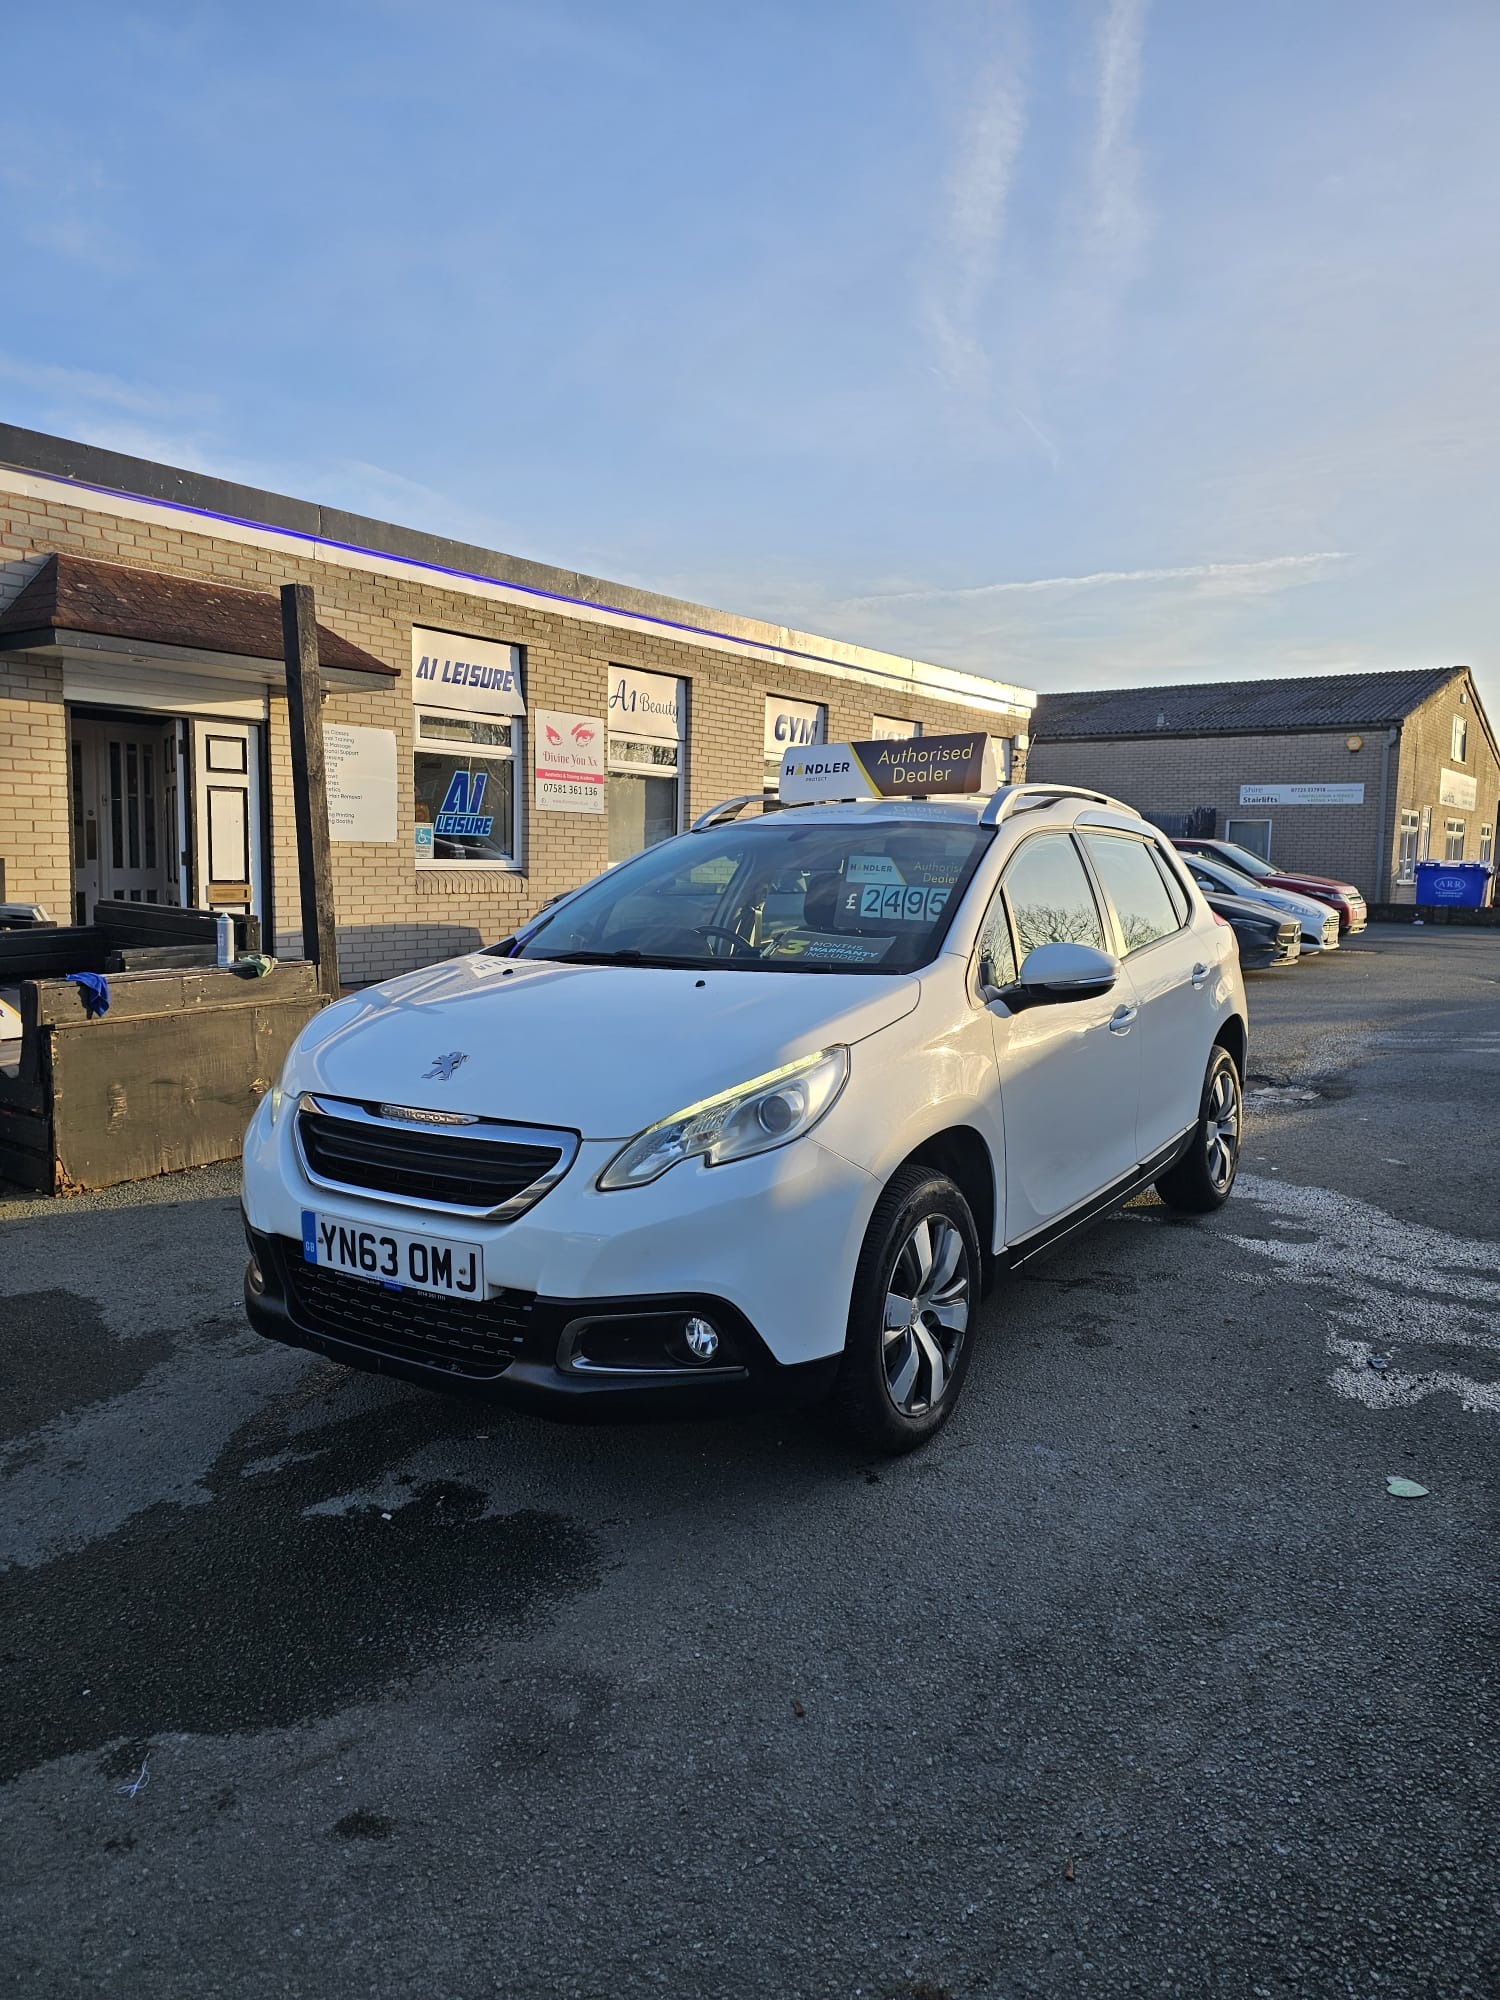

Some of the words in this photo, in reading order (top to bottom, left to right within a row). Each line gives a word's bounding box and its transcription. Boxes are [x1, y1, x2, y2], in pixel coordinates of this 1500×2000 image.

[441, 660, 514, 692] LEISURE
[609, 678, 636, 712] A1
[640, 692, 680, 723] Beauty
[774, 714, 818, 744] GYM
[543, 751, 569, 764] Divine
[571, 754, 586, 767] You
[877, 742, 974, 765] Authorised
[893, 764, 952, 784] Dealer
[544, 784, 566, 794] 07581
[569, 786, 582, 794] 361
[585, 787, 598, 796] 136
[434, 814, 494, 836] LEISURE
[845, 893, 858, 910] £
[864, 889, 947, 915] 2495
[778, 940, 810, 954] 3
[810, 946, 879, 958] WARRANTY
[813, 941, 864, 951] MONTHS
[804, 952, 864, 962] INCLUDED
[305, 1242, 315, 1252] GB
[320, 1222, 398, 1276] YN63
[408, 1243, 476, 1292] OMJ
